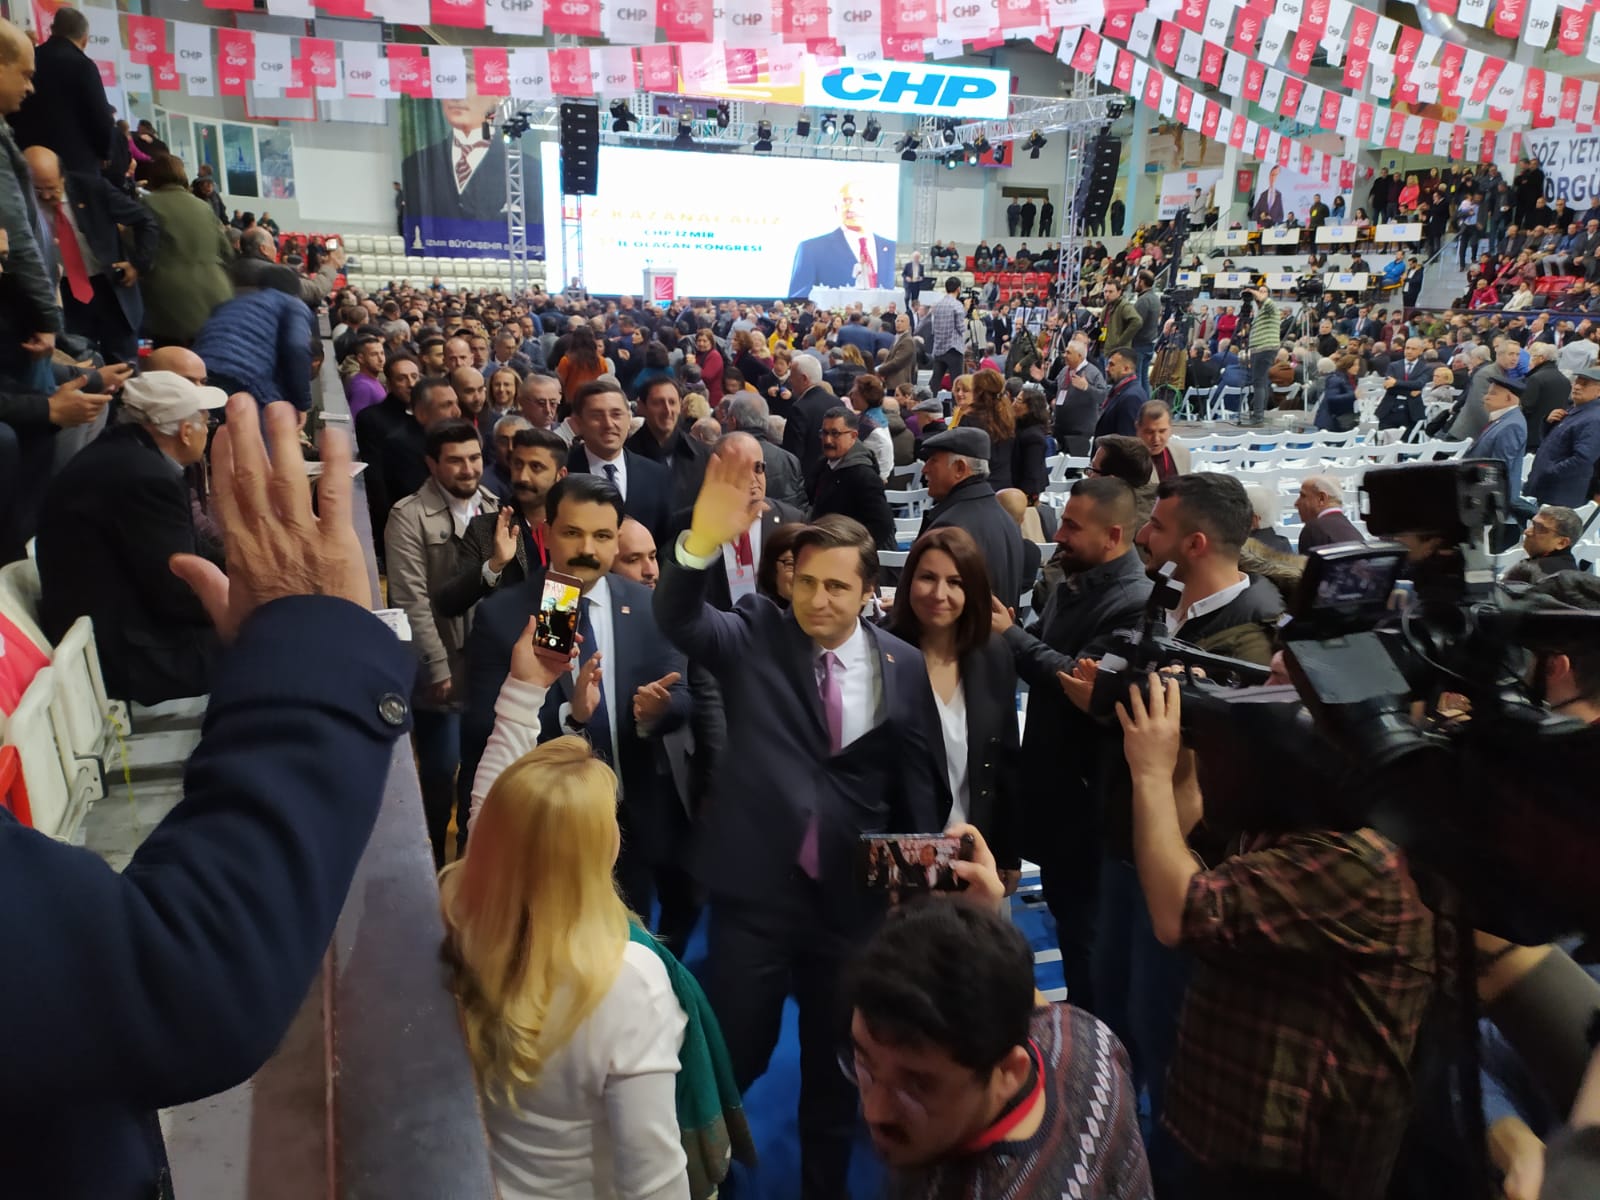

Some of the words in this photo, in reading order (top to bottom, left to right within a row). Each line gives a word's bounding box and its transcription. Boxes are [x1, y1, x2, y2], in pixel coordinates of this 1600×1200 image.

[561, 2, 590, 15] CHP
[952, 4, 980, 18] CHP
[1186, 7, 1201, 18] CHP
[1282, 3, 1298, 14] CHP
[617, 8, 647, 21] CHP
[676, 12, 703, 25] CHP
[732, 13, 762, 26] CHP
[792, 13, 818, 26] CHP
[843, 10, 872, 22] CHP
[901, 10, 927, 22] CHP
[1309, 14, 1323, 24] CHP
[1500, 10, 1517, 22] CHP
[1209, 18, 1225, 29] CHP
[1530, 18, 1549, 29] CHP
[1328, 26, 1340, 36] CHP
[1563, 29, 1579, 40] CHP
[89, 35, 110, 44] CHP
[1240, 31, 1253, 42] CHP
[1353, 36, 1365, 47] CHP
[134, 43, 157, 52] CHP
[1265, 41, 1278, 50] CHP
[1377, 41, 1389, 51] CHP
[180, 49, 202, 60] CHP
[1296, 52, 1310, 62] CHP
[226, 56, 247, 66] CHP
[261, 62, 283, 72] CHP
[311, 65, 331, 74] CHP
[125, 72, 142, 80] CHP
[160, 72, 175, 81] CHP
[350, 70, 372, 80] CHP
[399, 72, 418, 80] CHP
[651, 71, 671, 80] CHP
[1349, 68, 1362, 78] CHP
[190, 76, 207, 84] CHP
[435, 75, 457, 84] CHP
[485, 75, 504, 83] CHP
[522, 76, 543, 85] CHP
[606, 75, 627, 84] CHP
[1376, 75, 1388, 84] CHP
[822, 66, 996, 107] CHP
[1402, 84, 1415, 92] CHP
[1499, 86, 1514, 95] CHP
